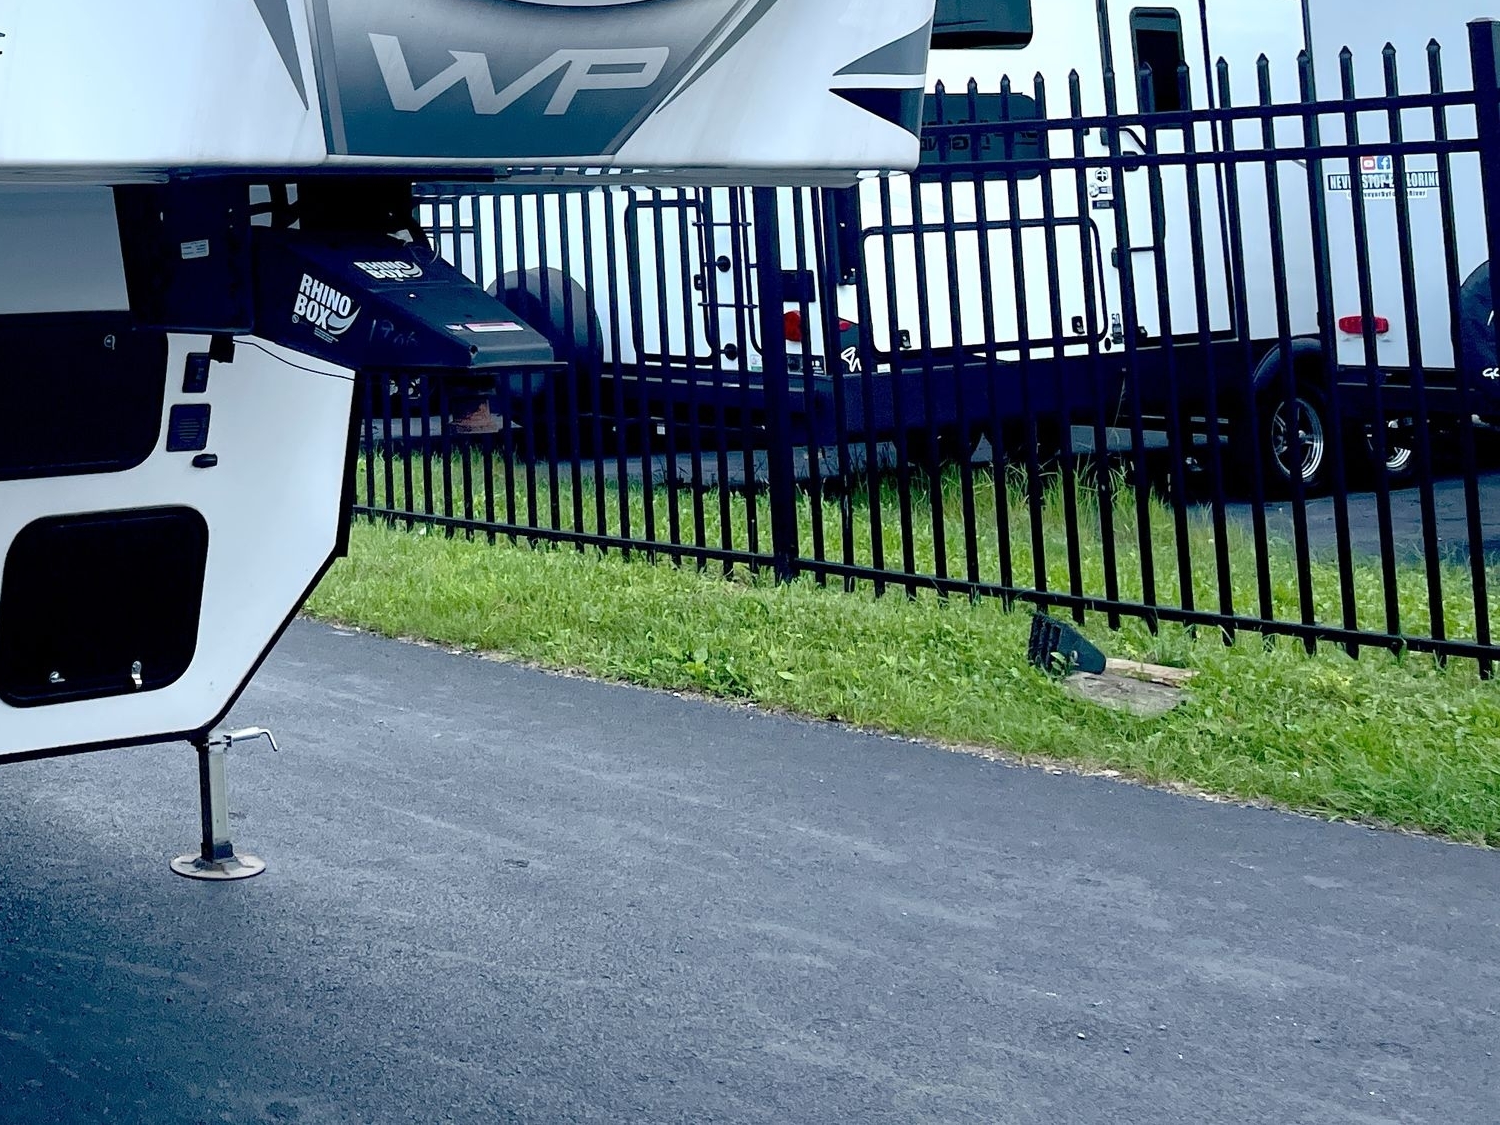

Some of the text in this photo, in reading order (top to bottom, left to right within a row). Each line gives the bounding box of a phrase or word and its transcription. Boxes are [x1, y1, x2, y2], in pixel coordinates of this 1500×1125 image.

[368, 33, 669, 115] WP
[293, 293, 331, 330] BOX
[299, 273, 352, 316] RHINO
